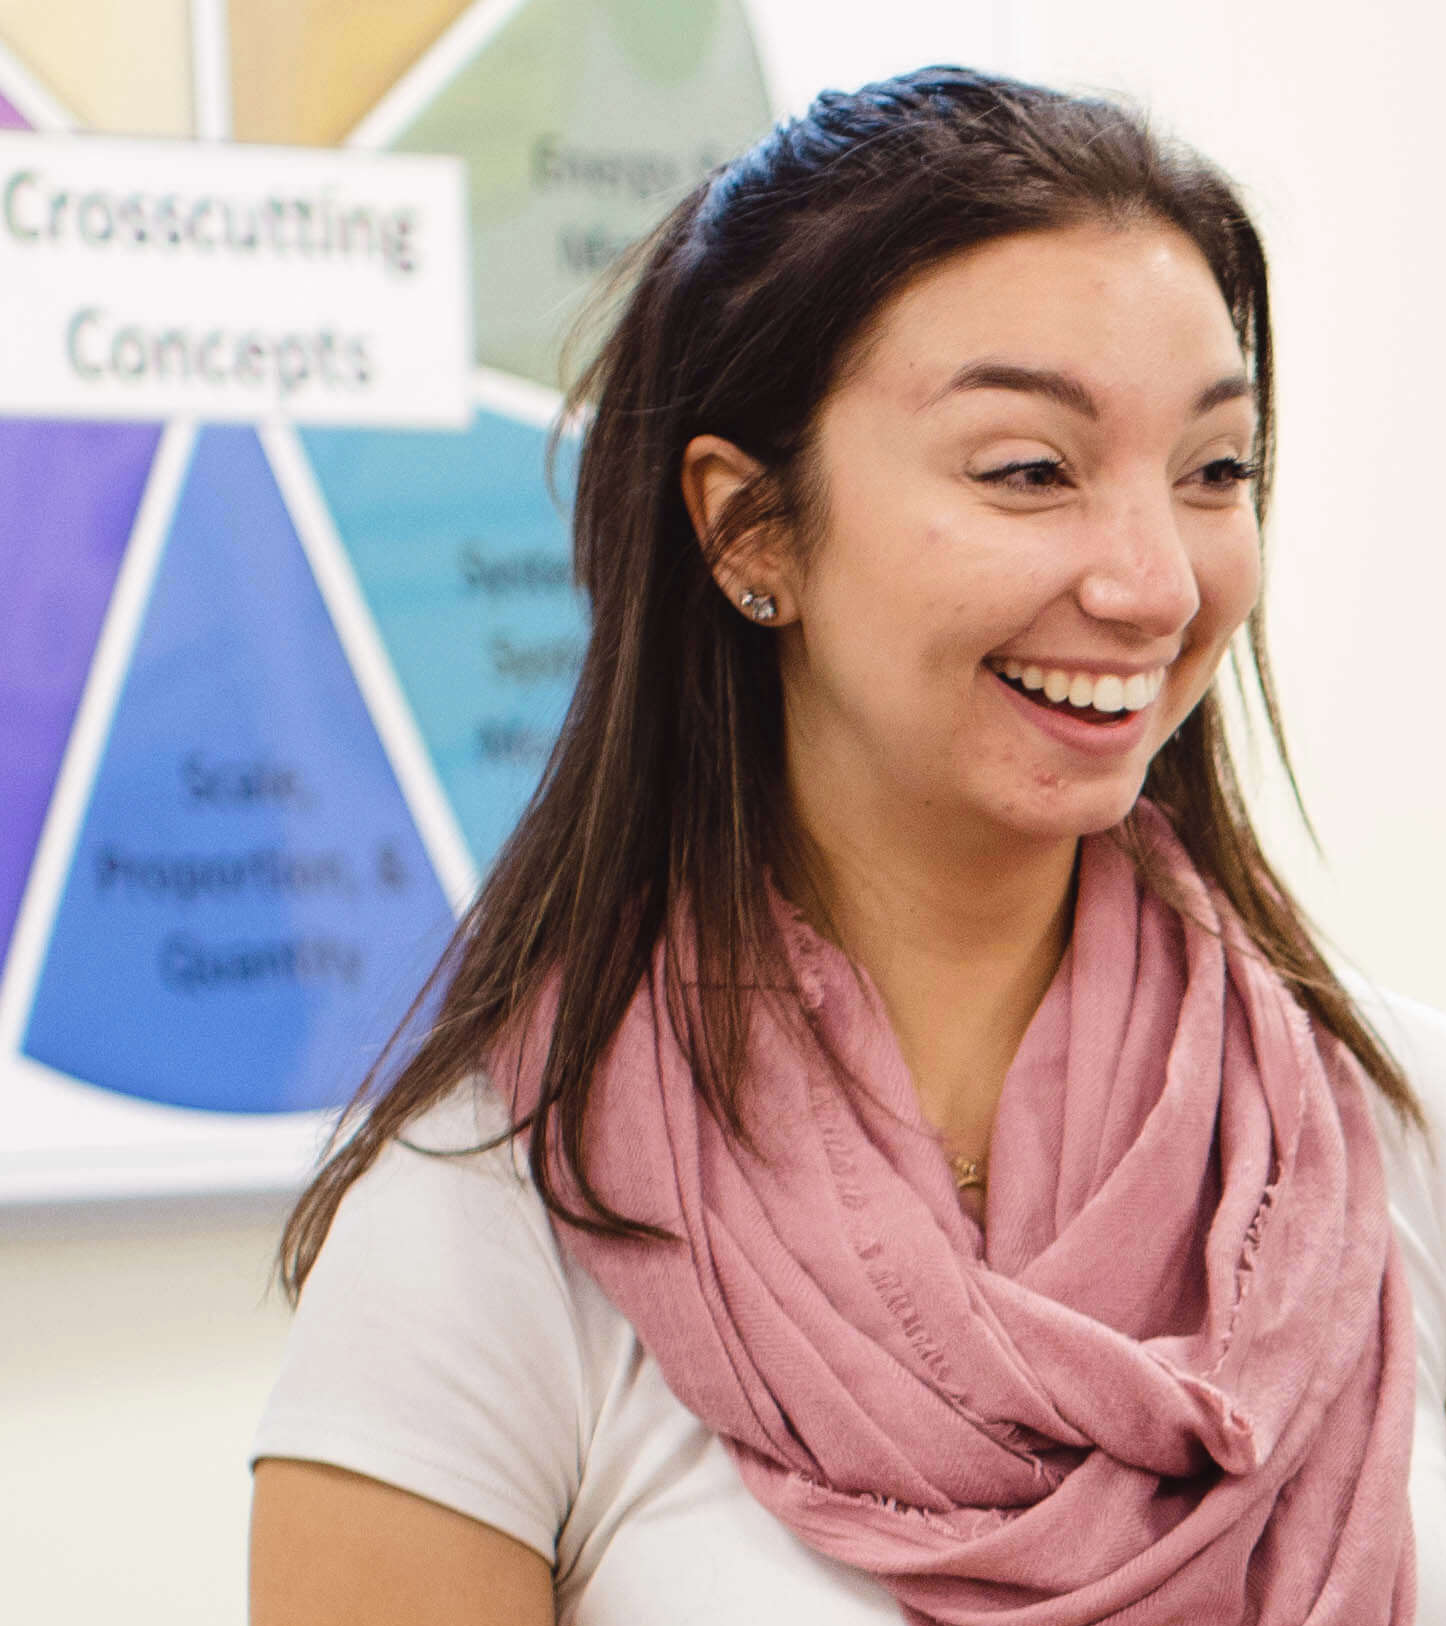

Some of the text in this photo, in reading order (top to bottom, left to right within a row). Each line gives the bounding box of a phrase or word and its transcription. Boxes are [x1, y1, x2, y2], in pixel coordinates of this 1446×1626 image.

[2, 168, 418, 272] Crosscutting
[66, 304, 374, 396] Concepts
[182, 752, 311, 808] Scale,
[96, 842, 408, 900] Proportion, &
[161, 932, 361, 992] Quantity
